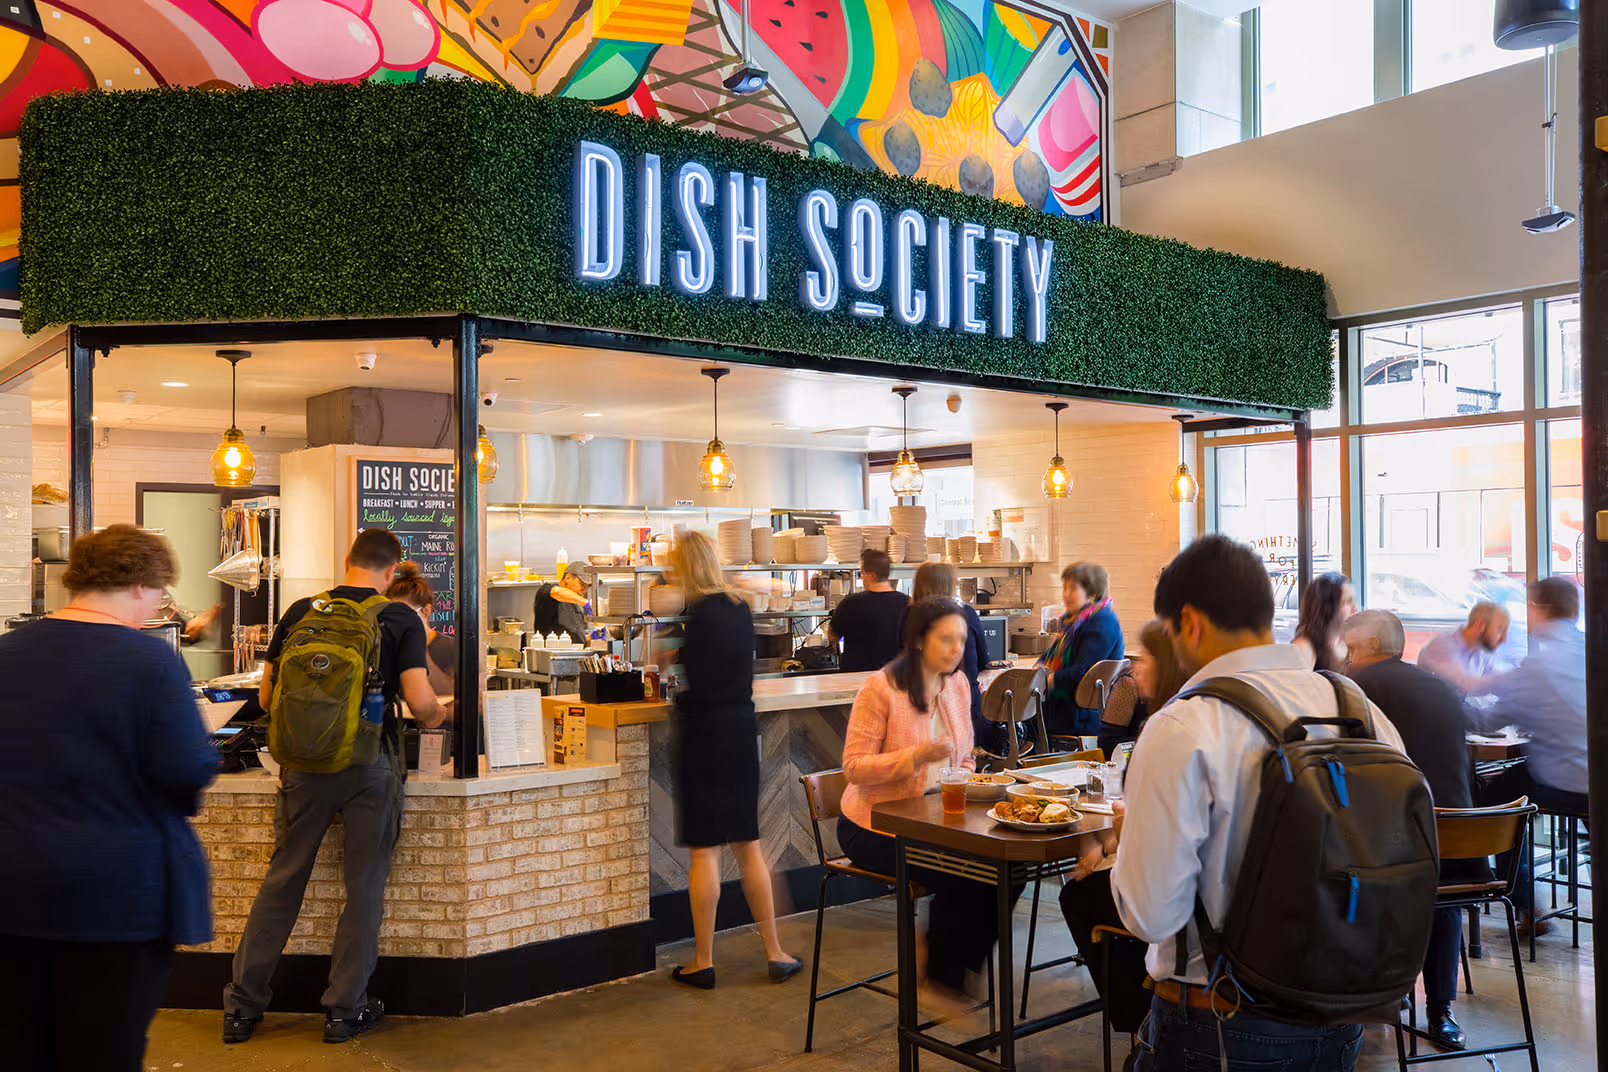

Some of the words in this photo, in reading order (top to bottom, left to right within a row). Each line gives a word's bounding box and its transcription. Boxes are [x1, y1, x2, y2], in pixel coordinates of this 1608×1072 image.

[578, 139, 768, 301] DISH
[805, 189, 1055, 343] SOCIETY
[362, 465, 402, 491] DISH
[409, 467, 455, 492] SOCIE
[362, 498, 394, 508] BREAKFAST
[400, 499, 418, 508] LUNCH
[424, 500, 446, 509] SUPPER
[363, 508, 398, 530] locally
[401, 510, 436, 523] sourced
[421, 541, 442, 552] MAINE
